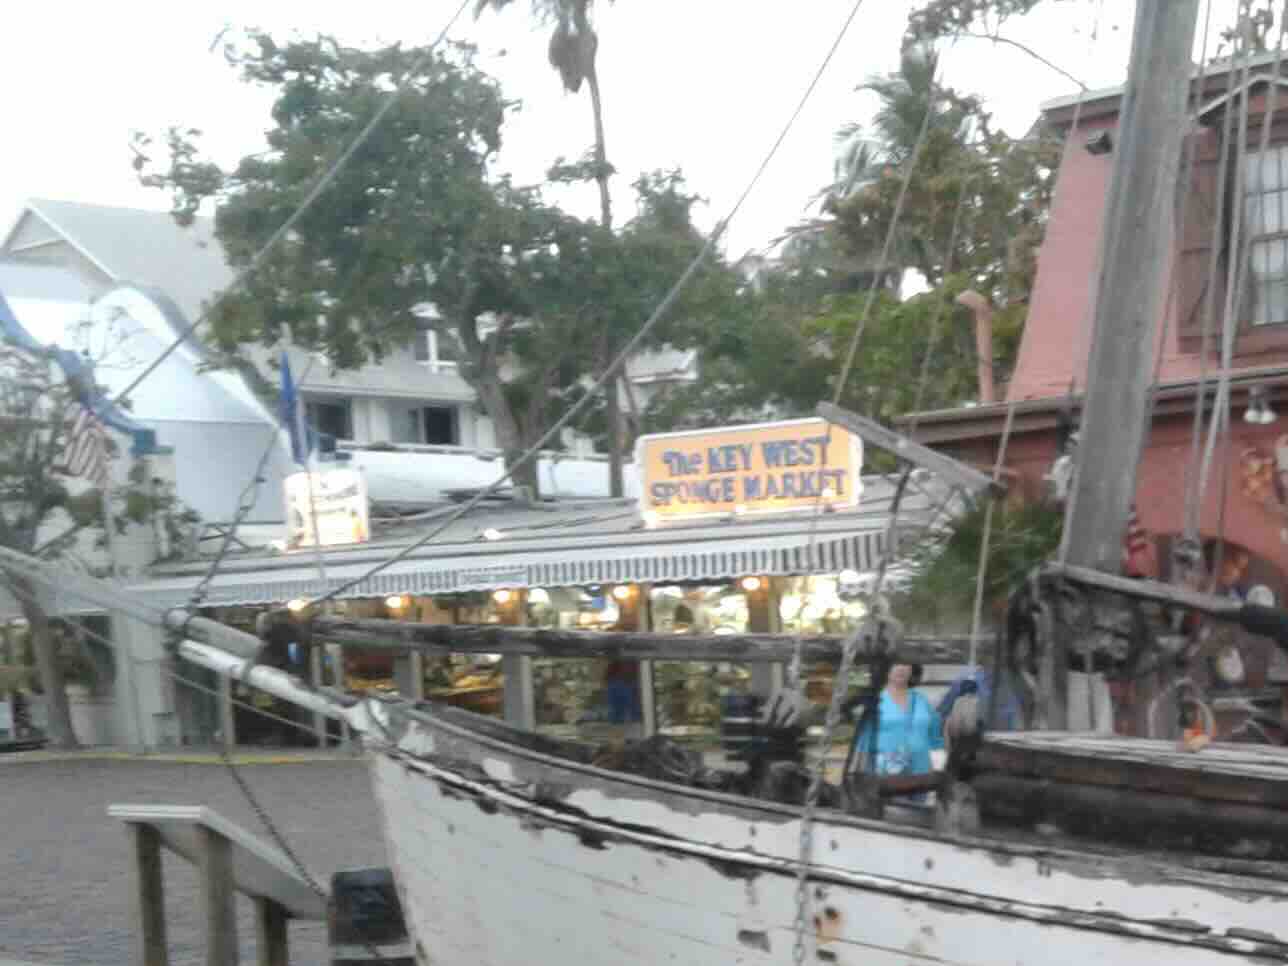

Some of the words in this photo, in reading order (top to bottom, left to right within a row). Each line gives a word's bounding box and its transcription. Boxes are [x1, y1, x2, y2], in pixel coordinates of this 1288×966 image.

[662, 451, 702, 476] The
[707, 444, 753, 474] KEY
[761, 434, 832, 467] WEST
[651, 477, 736, 506] SPONGE
[741, 468, 846, 501] MARKET
